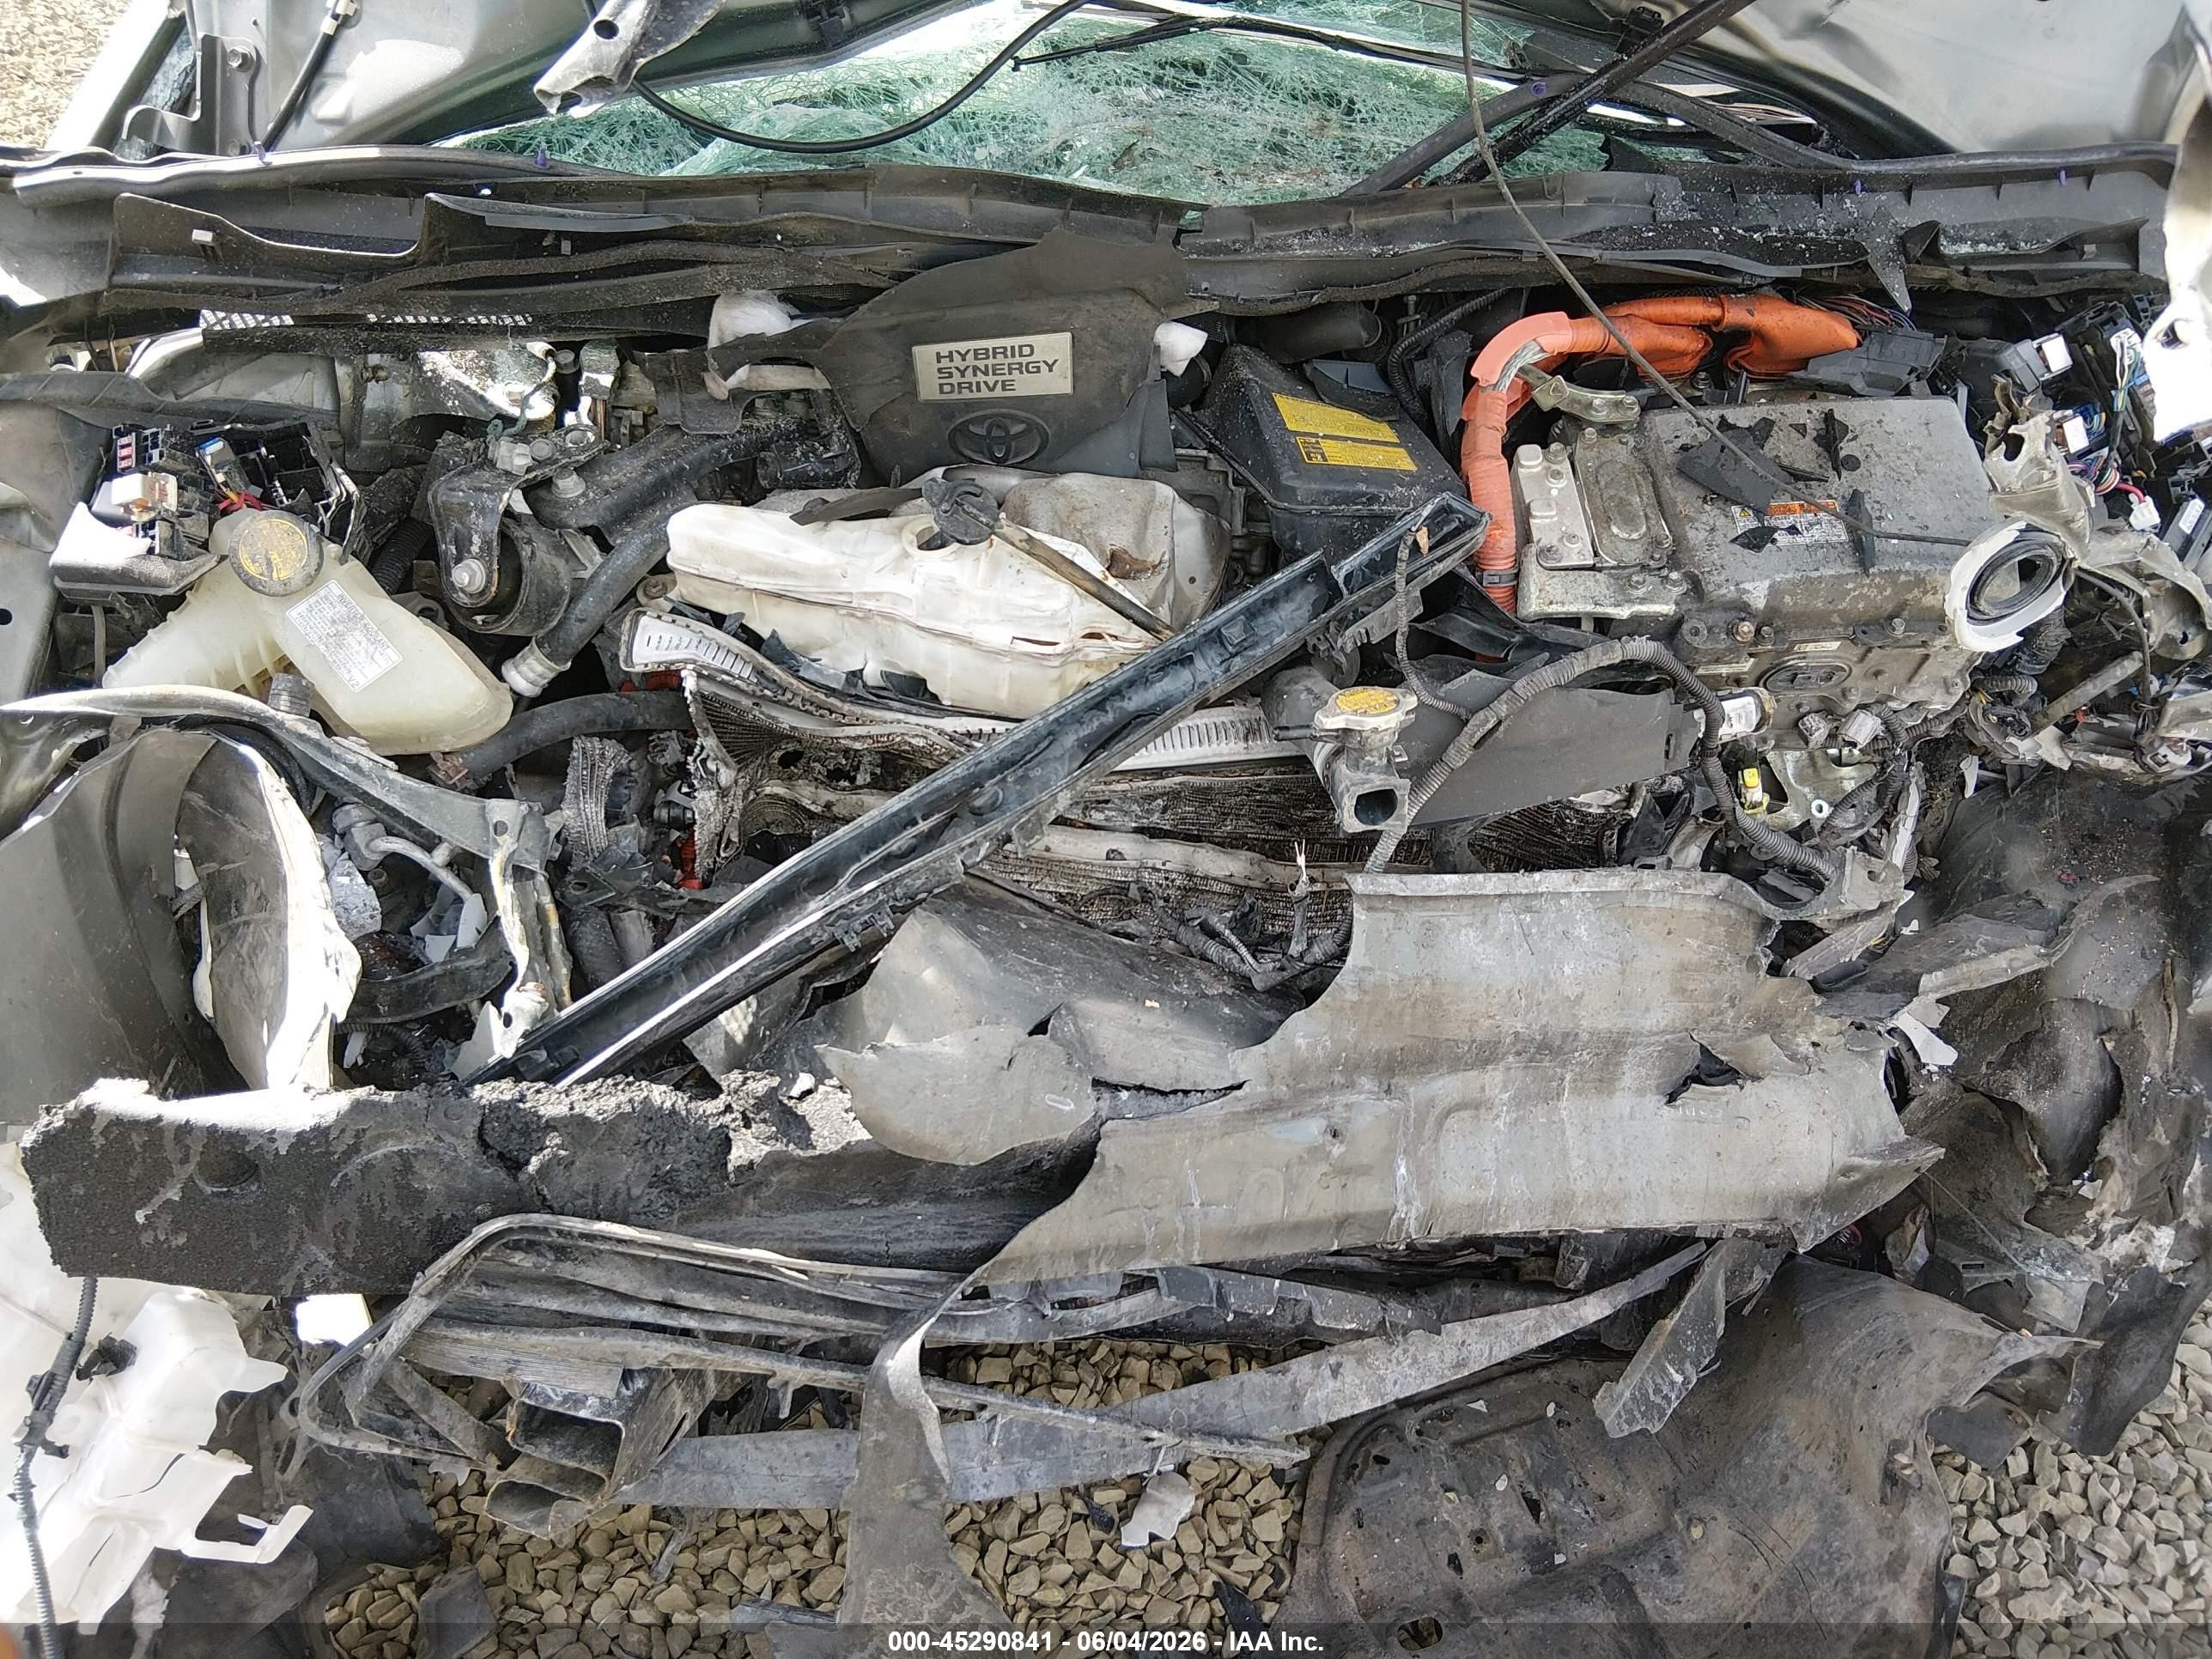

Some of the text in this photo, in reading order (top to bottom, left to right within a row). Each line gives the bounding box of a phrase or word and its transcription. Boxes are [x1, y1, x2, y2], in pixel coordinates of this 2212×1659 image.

[936, 344, 1035, 363] HYBRID
[937, 359, 1059, 380] SYNERGY
[939, 380, 1016, 395] DRIVE
